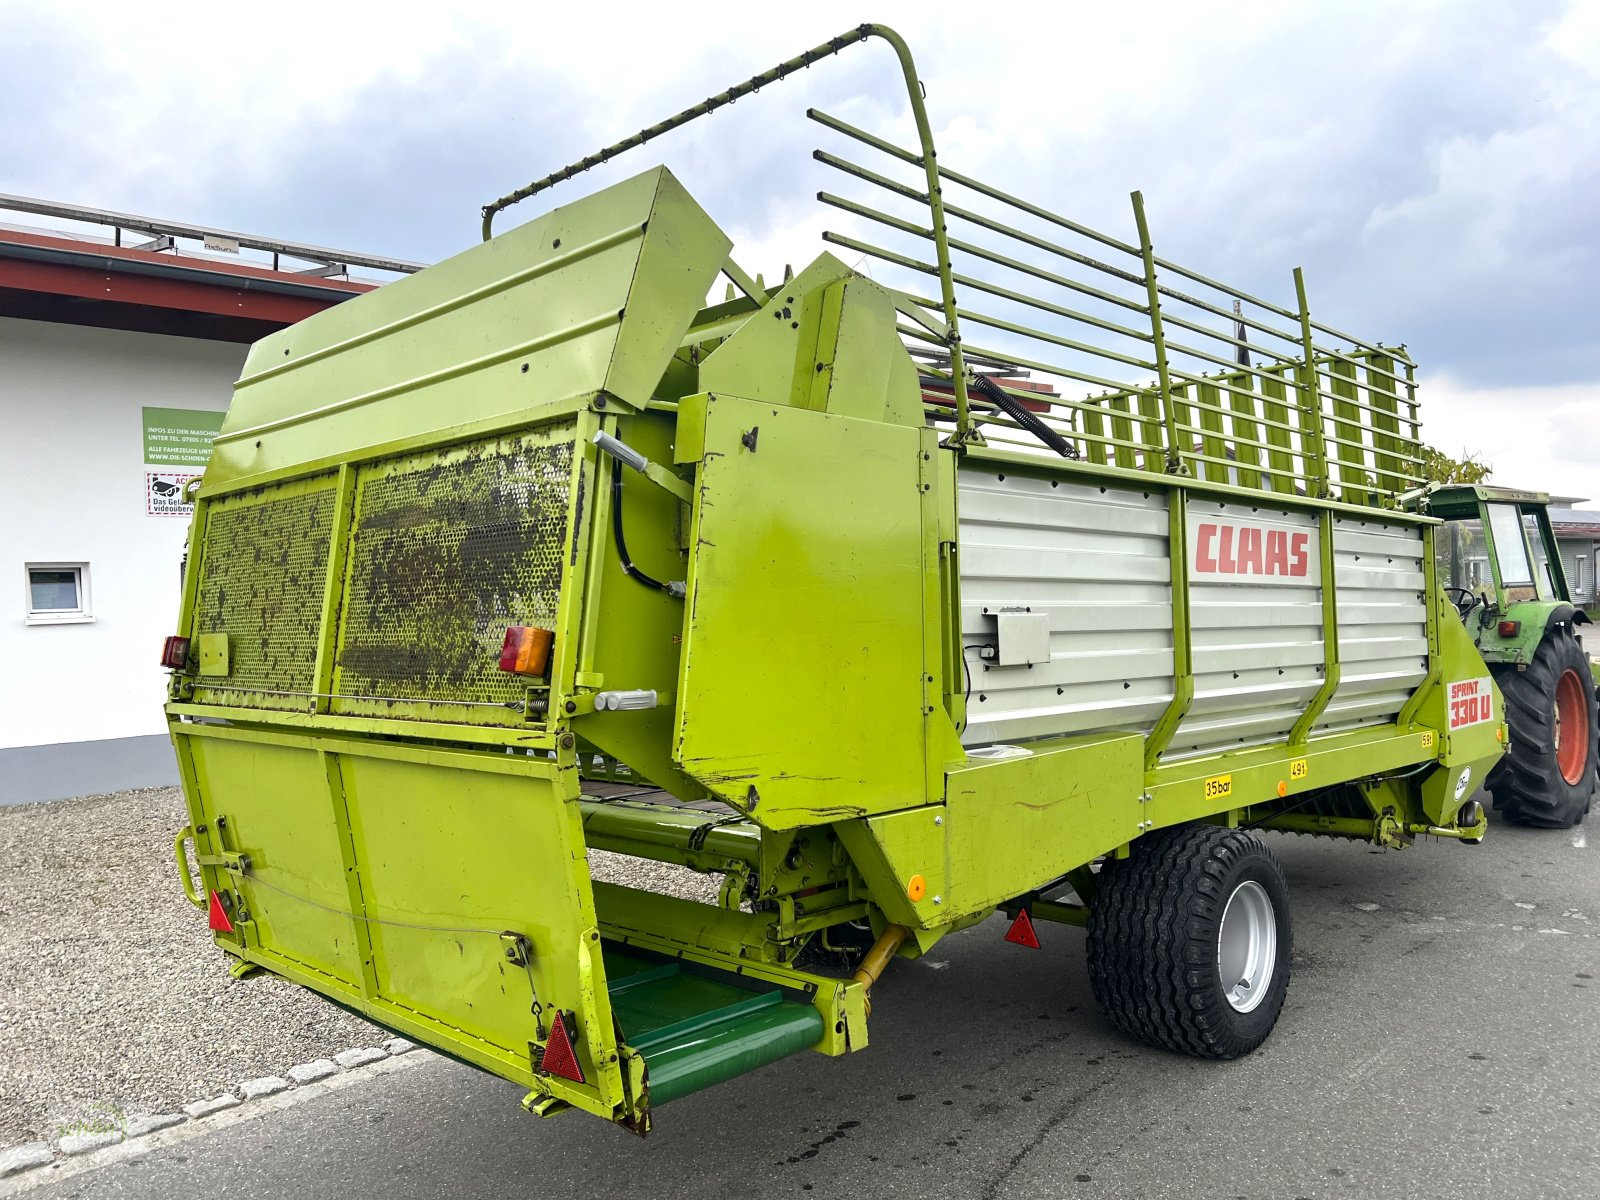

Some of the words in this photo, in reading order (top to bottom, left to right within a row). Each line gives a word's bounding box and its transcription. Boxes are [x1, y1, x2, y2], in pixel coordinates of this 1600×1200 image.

[163, 446, 198, 454] FAHRZEUGE
[1195, 523, 1308, 577] CLAAS
[1451, 681, 1478, 699] SPRINT
[1451, 697, 1478, 728] 330
[1480, 695, 1490, 720] U
